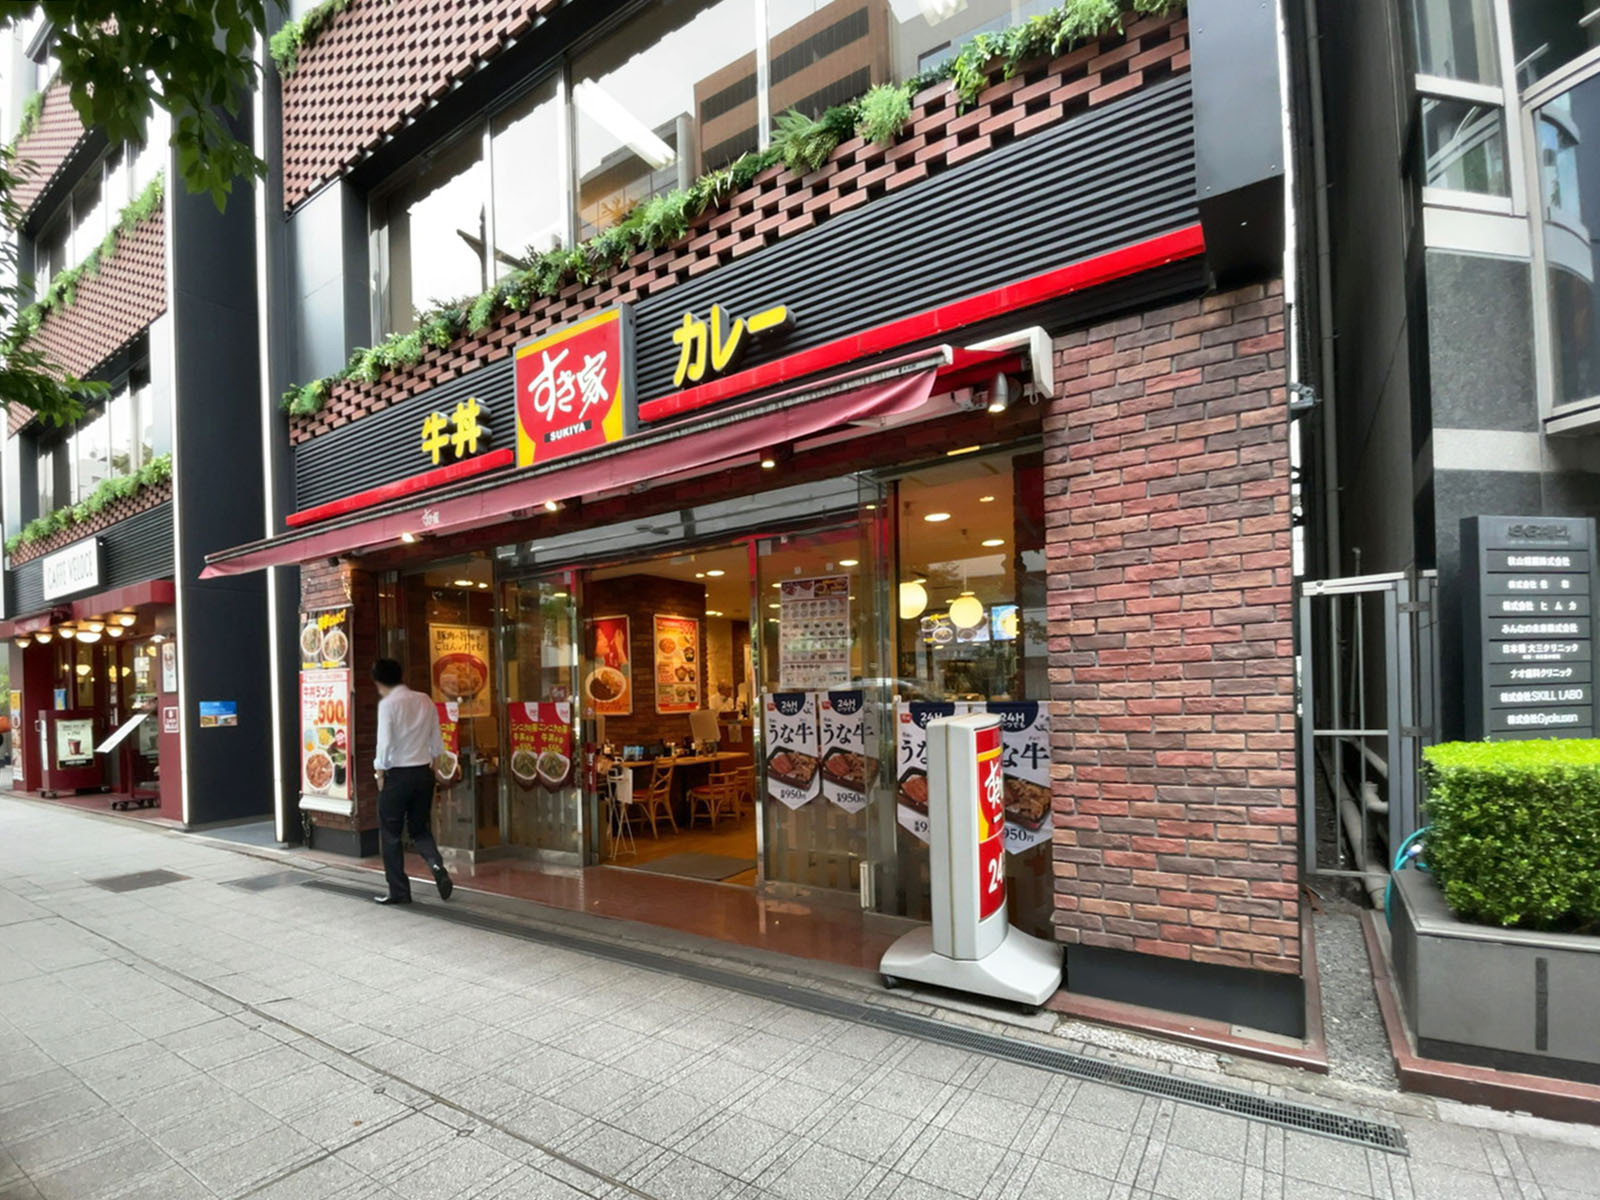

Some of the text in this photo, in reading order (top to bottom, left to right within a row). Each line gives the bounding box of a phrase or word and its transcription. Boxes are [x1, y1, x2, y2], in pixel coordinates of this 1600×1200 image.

[672, 303, 787, 387] カレー
[528, 348, 608, 421] すき家
[421, 397, 481, 465] 牛丼
[550, 422, 586, 441] SUKIYA
[781, 701, 798, 709] 24H
[838, 699, 856, 708] 24H
[1558, 689, 1583, 700] LABO
[318, 699, 344, 724] 500
[1000, 712, 1025, 722] 24H
[769, 722, 814, 745] うな牛
[823, 722, 874, 745] うな牛
